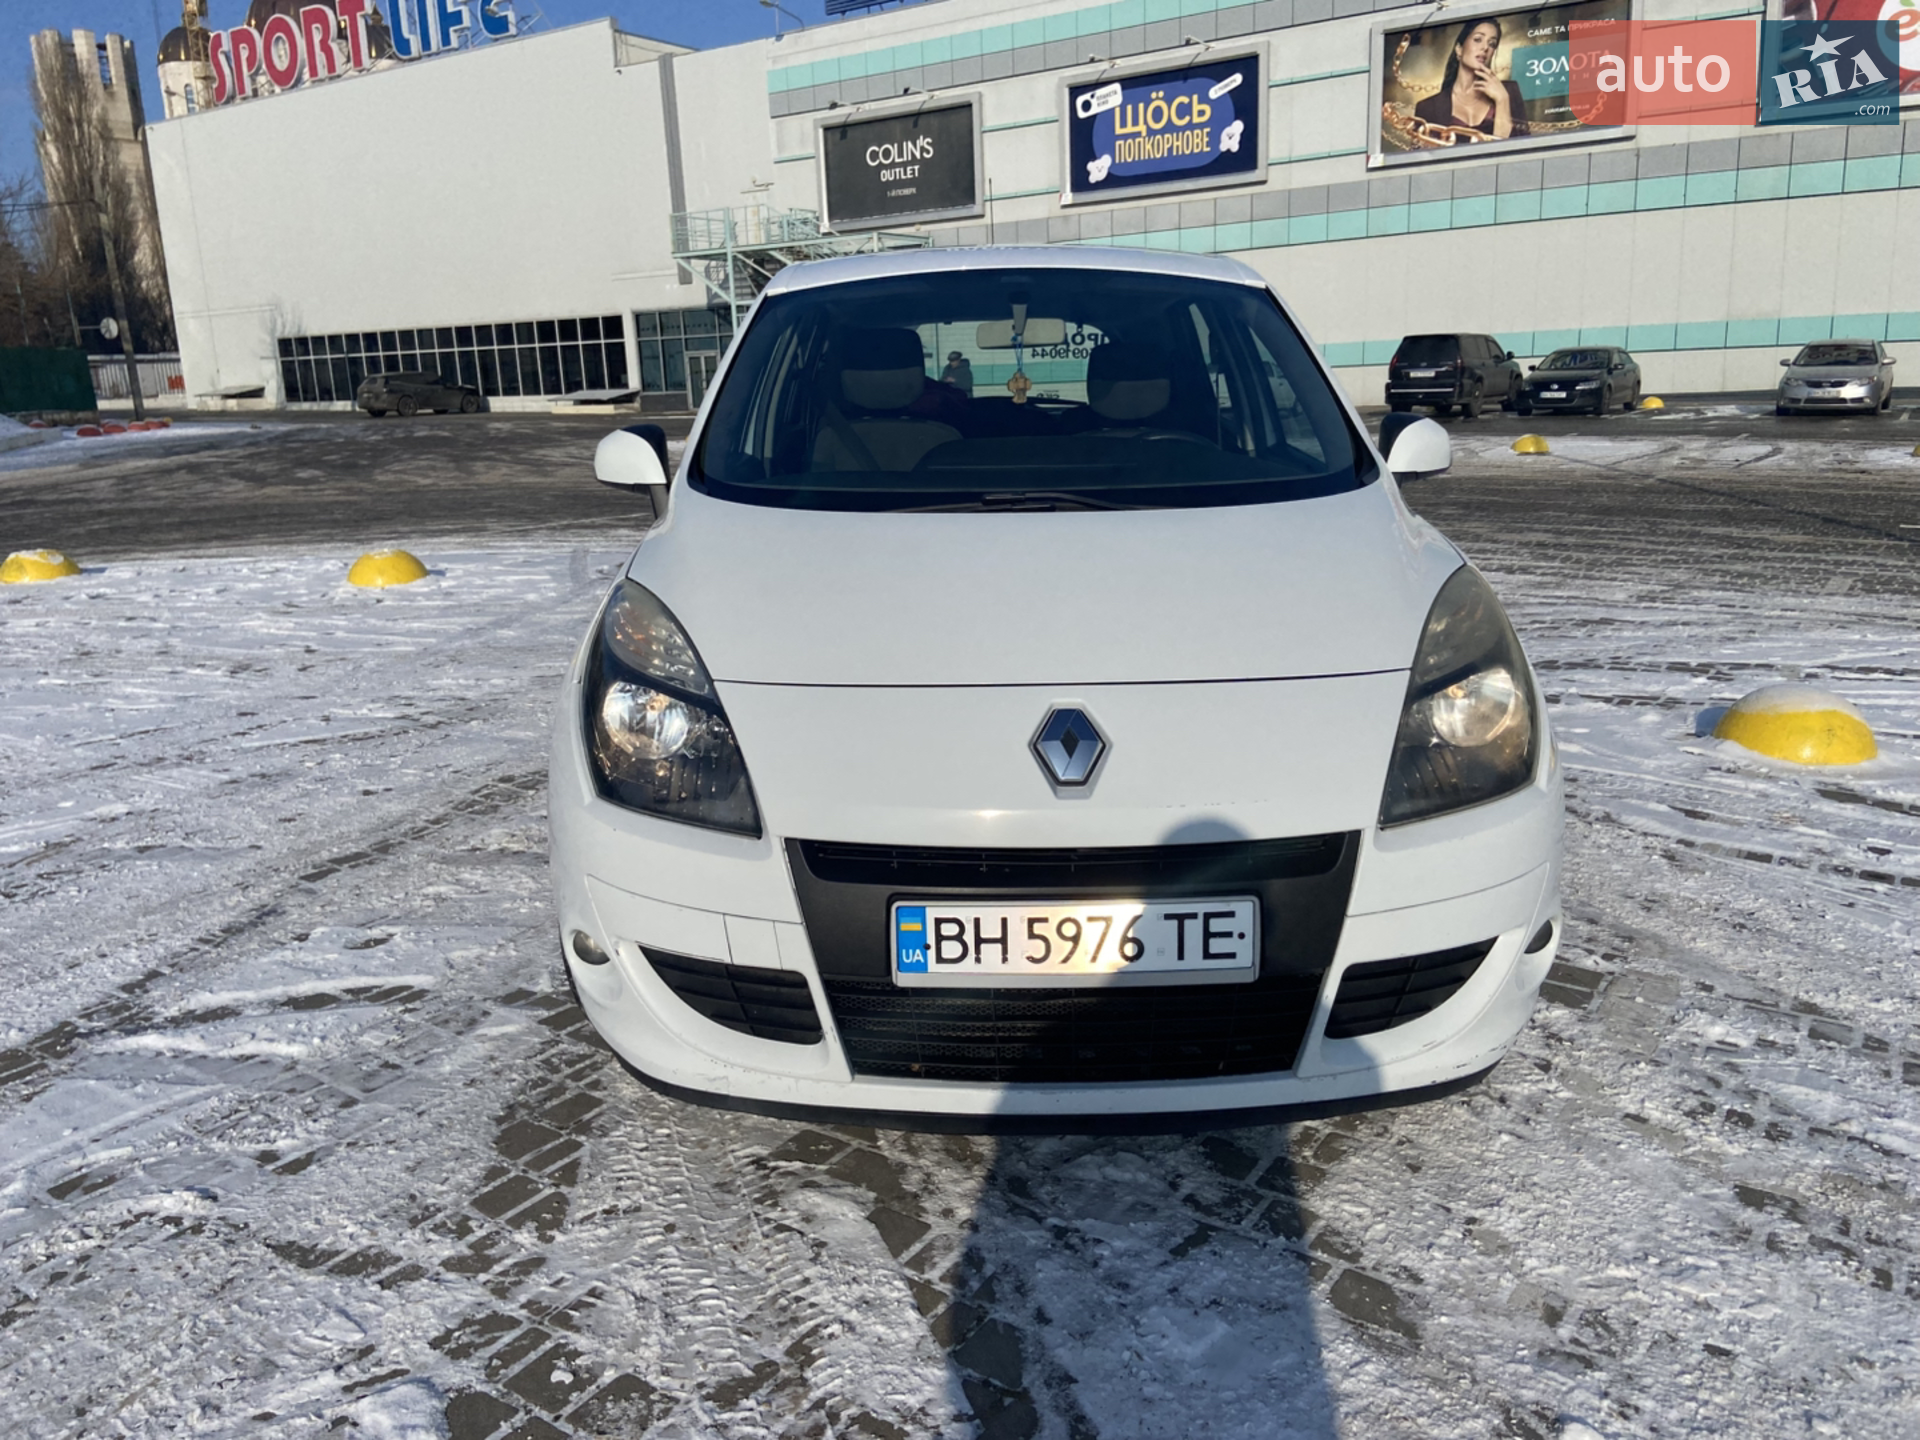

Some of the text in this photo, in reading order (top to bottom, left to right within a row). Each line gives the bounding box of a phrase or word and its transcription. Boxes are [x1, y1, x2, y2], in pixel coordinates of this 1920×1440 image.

[1527, 26, 1553, 38] САМЕ
[1554, 24, 1566, 34] ТА
[208, 0, 372, 104] SPORT
[1525, 49, 1615, 77] ЗОЛОТА
[866, 135, 934, 167] COLIN'S
[1115, 127, 1212, 164] ПОПКОРНОВЕ
[880, 165, 920, 182] OUTLET
[934, 910, 1237, 965] BH 5976 TE
[902, 948, 925, 964] UA
